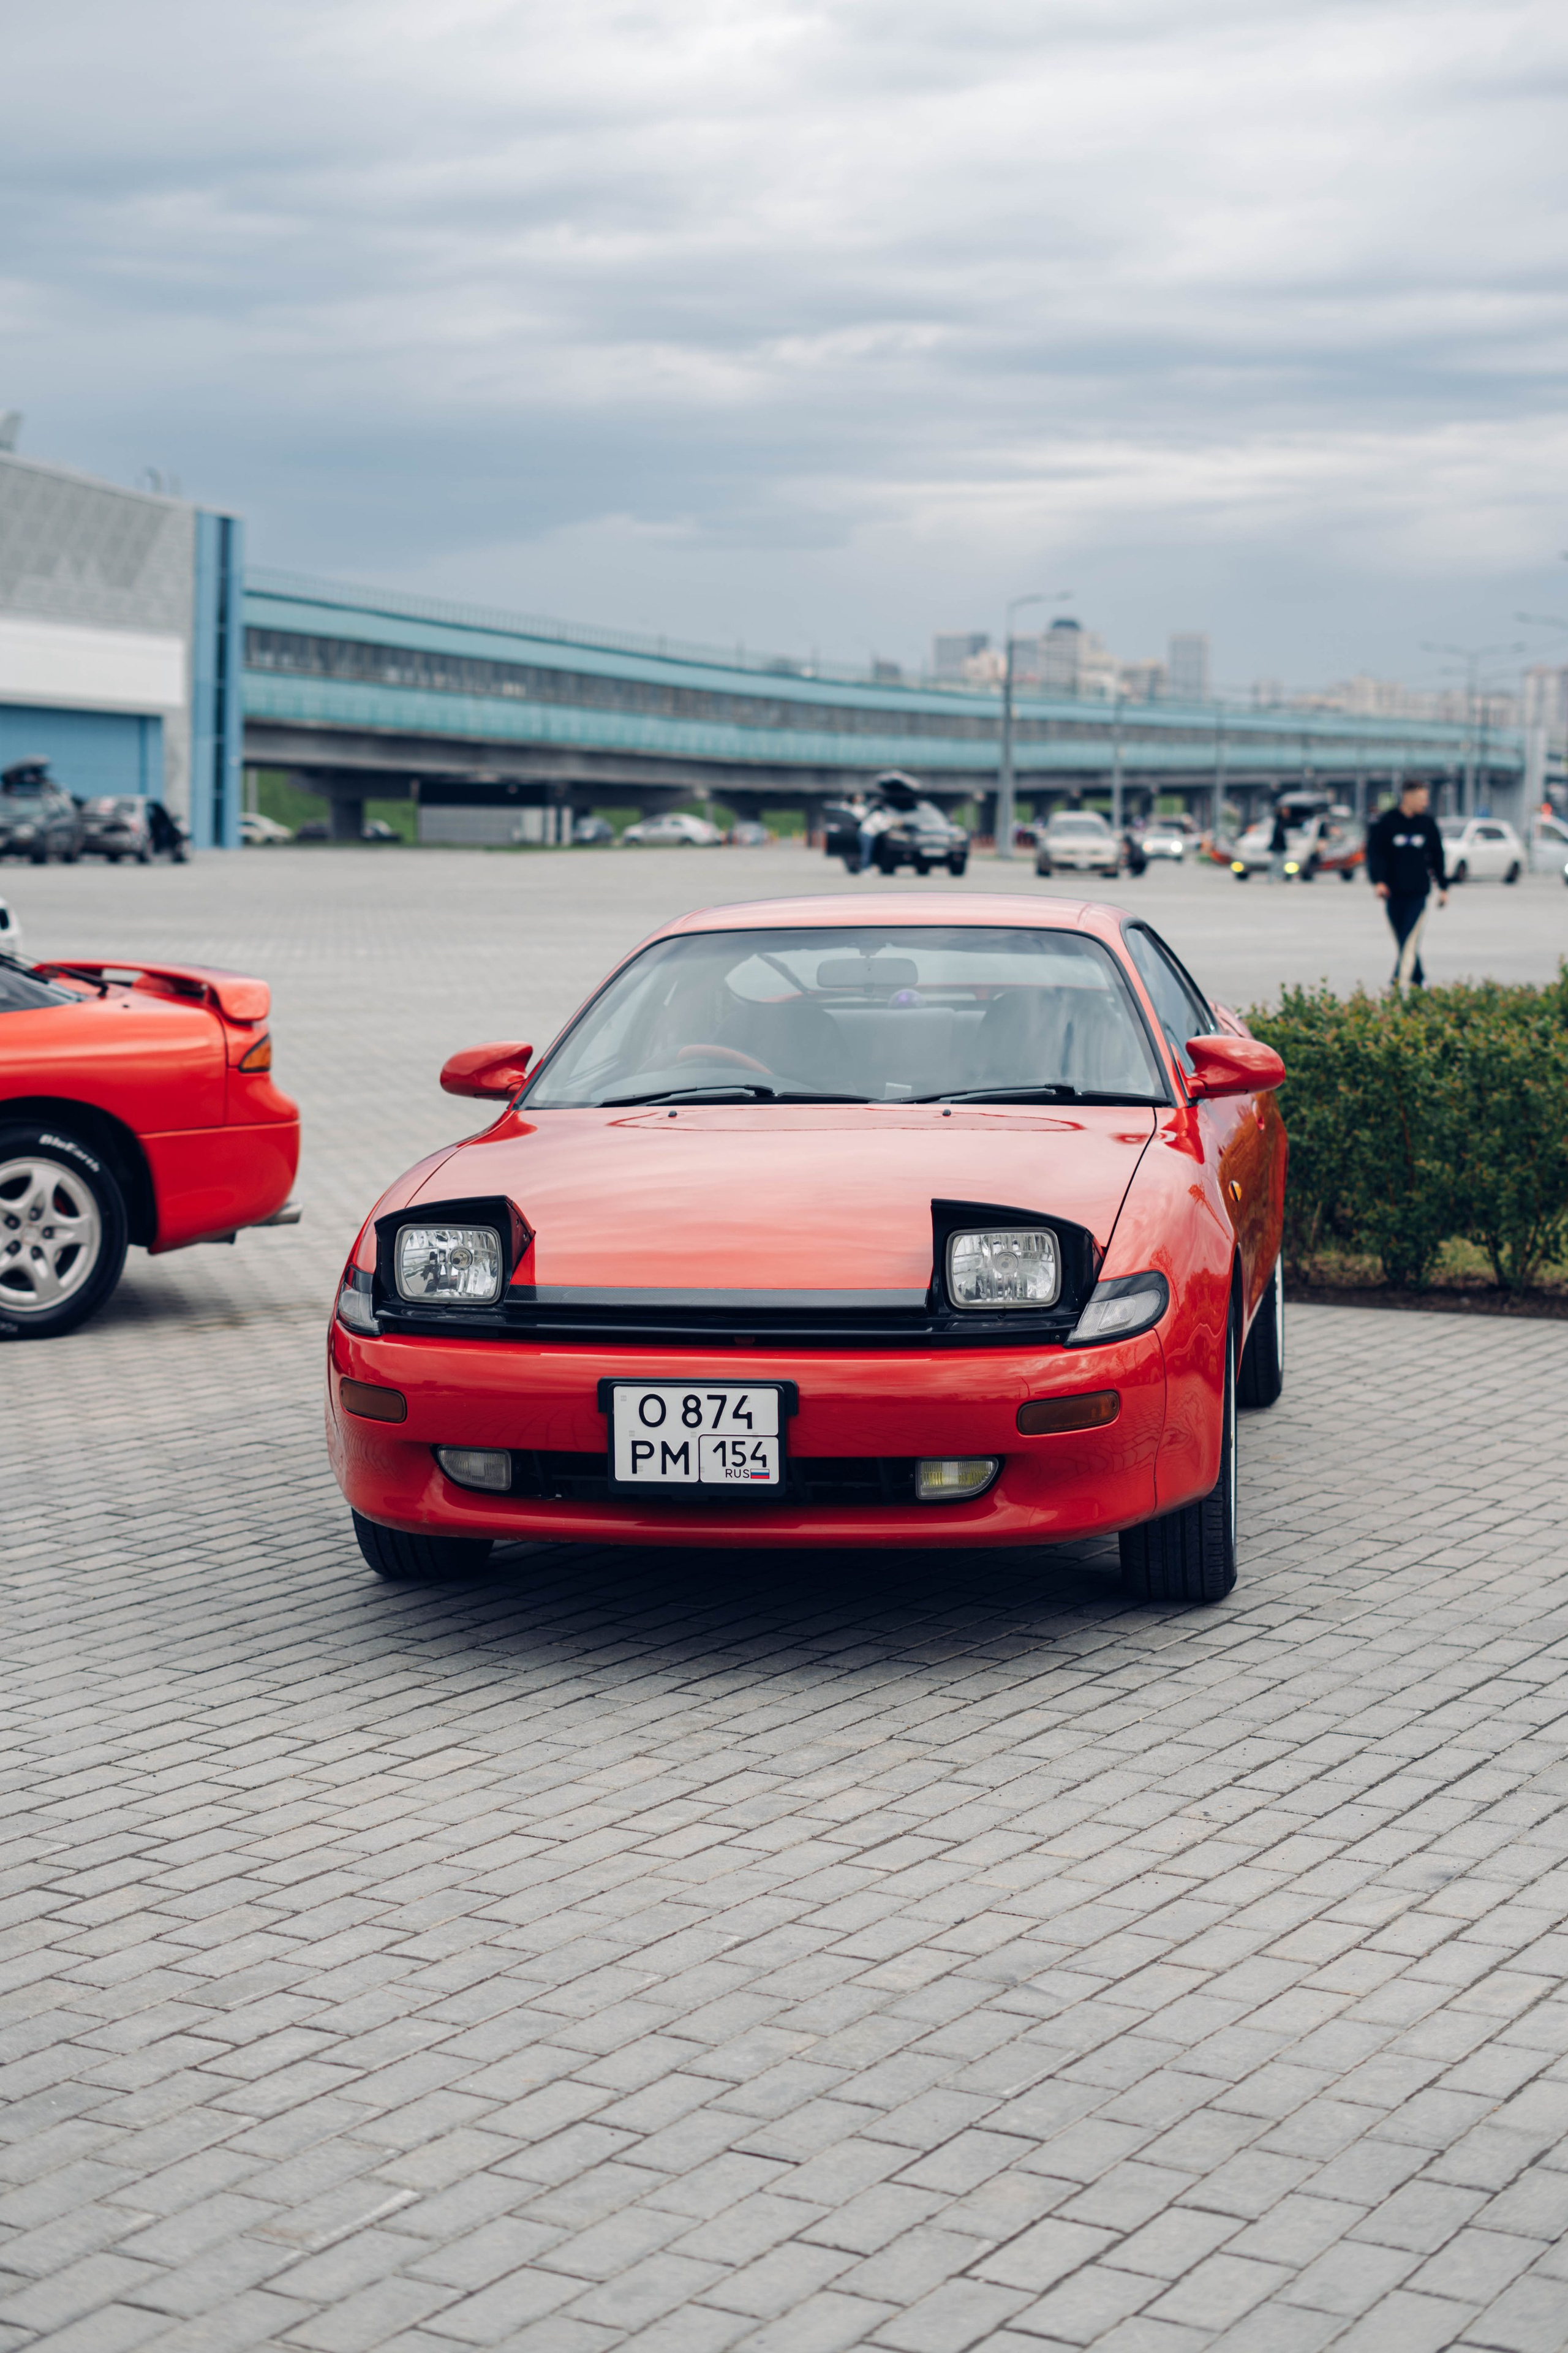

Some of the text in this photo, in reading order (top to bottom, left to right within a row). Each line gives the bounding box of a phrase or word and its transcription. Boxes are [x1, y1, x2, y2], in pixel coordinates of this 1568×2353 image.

[639, 1394, 753, 1429] O 874
[631, 1440, 689, 1475] PM
[712, 1441, 767, 1468] 154
[725, 1469, 750, 1478] RUS
